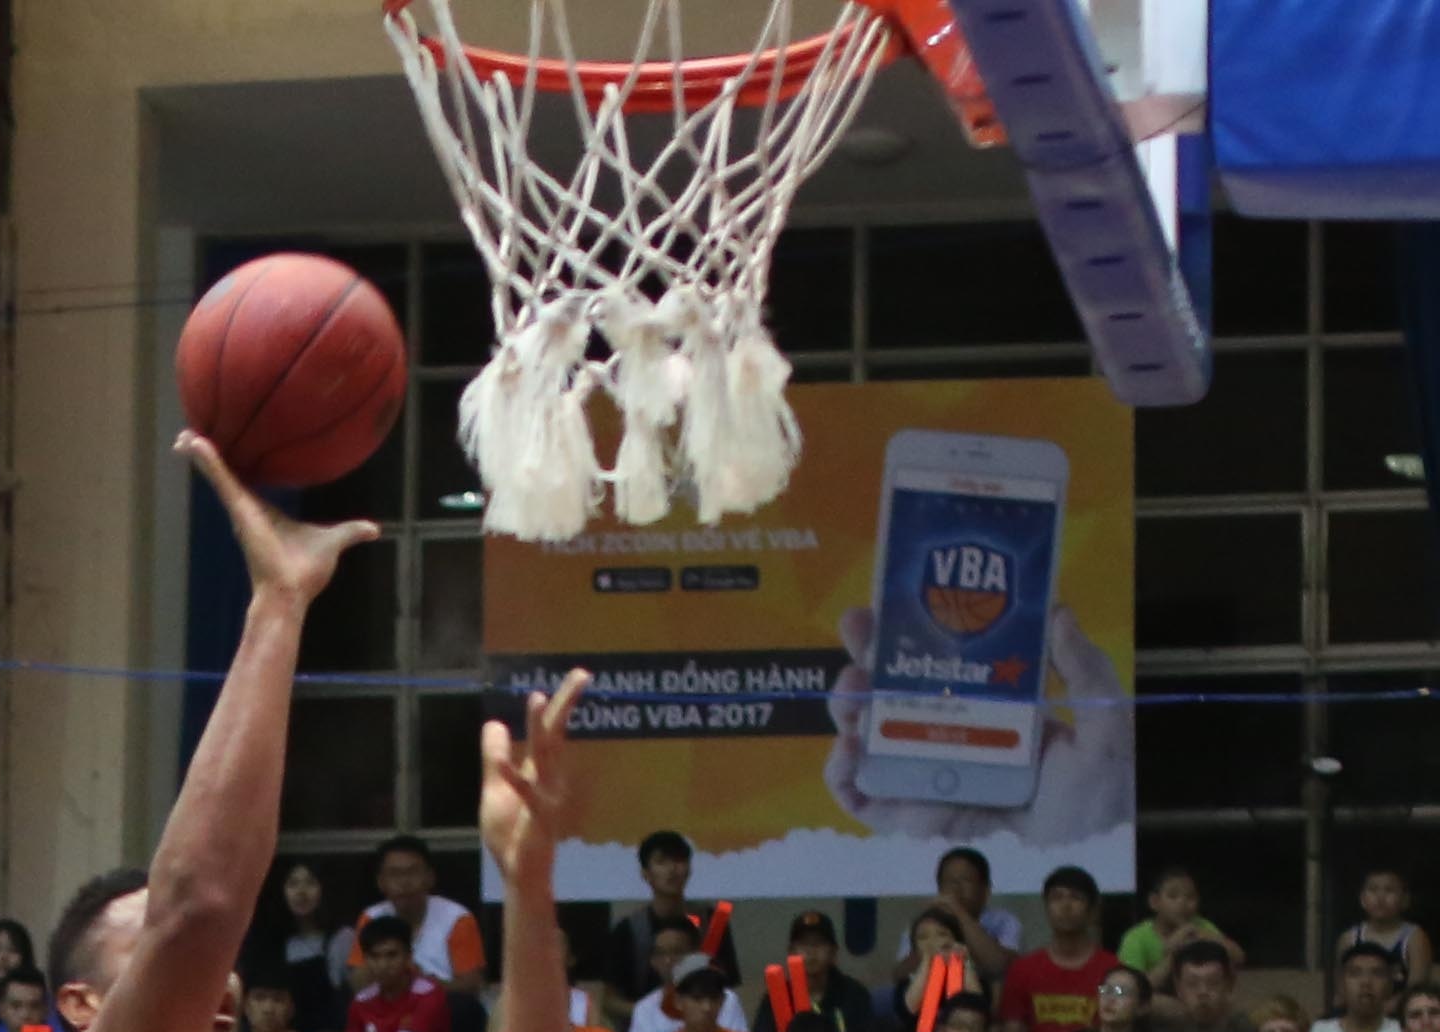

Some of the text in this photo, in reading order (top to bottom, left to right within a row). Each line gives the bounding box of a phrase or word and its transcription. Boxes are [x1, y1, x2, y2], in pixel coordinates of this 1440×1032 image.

[768, 527, 819, 548] VBA
[933, 545, 1007, 592] VBA
[745, 660, 826, 692] HÀNH
[886, 650, 994, 684] Jetstar
[646, 703, 703, 728] VBA
[709, 702, 775, 727] 2017
